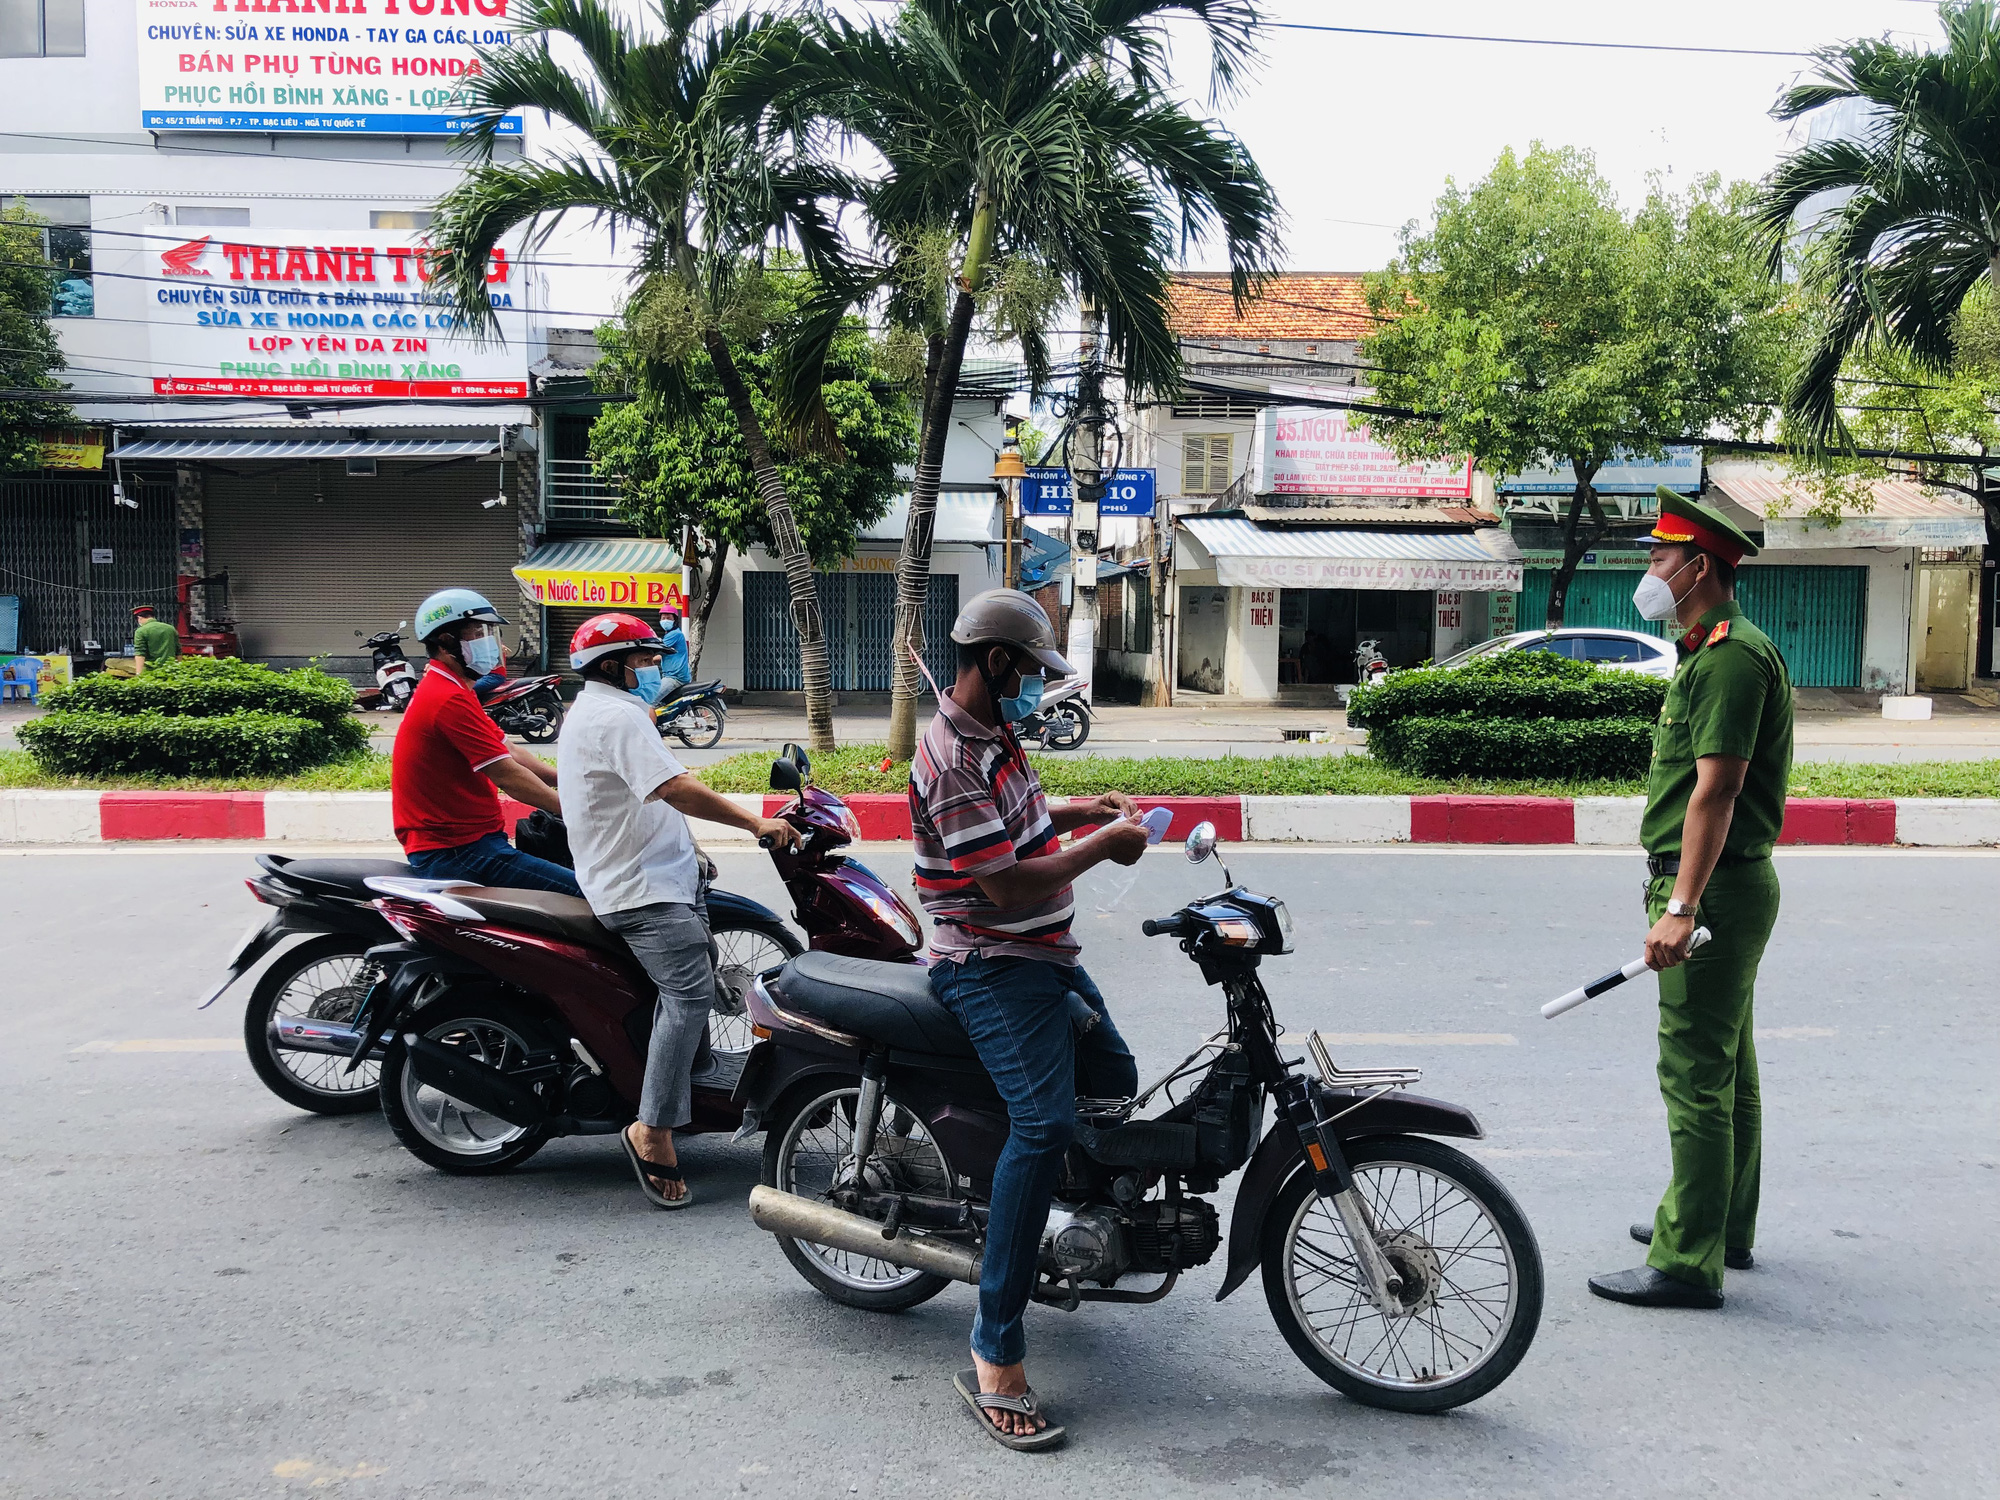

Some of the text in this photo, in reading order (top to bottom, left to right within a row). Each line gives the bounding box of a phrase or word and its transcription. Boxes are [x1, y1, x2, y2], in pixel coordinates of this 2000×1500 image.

[149, 0, 198, 8] HONDA
[147, 22, 221, 40] CHUYÊN:
[225, 19, 259, 41] SỬA
[264, 26, 286, 41] XE
[292, 26, 350, 42] HONDA
[366, 28, 399, 43] TAY
[405, 28, 427, 44] GA
[433, 26, 467, 45] CÁC
[178, 50, 483, 78] BÁN PHỤ TÙNG HONDA
[164, 86, 221, 107] PHỤC
[229, 81, 266, 105] HỒI
[273, 83, 324, 106] BÌNH
[332, 85, 389, 107] XĂNG
[409, 87, 450, 111] LỢP
[185, 116, 206, 125] TRẦN
[208, 116, 223, 126] PHÚ
[230, 118, 243, 126] P.7
[249, 118, 262, 127] TP.
[263, 117, 280, 128] BẠC
[305, 116, 321, 127] NGÃ
[321, 118, 334, 127] TƯ
[333, 117, 355, 128] QUỐC
[355, 117, 367, 128] TẾ
[162, 268, 212, 277] HONDA
[222, 244, 376, 283] THANH
[157, 286, 223, 304] CHUYÊN
[317, 291, 329, 306] &
[334, 288, 367, 306] BÁN
[196, 306, 242, 327] SỬA
[250, 312, 279, 326] XE
[288, 312, 364, 328] HONDA
[372, 310, 417, 329] CÁC
[248, 334, 427, 354] LỢP YÊN DA ZIN
[290, 357, 329, 378] HỒI
[338, 360, 391, 378] BÌNH
[400, 360, 461, 378] XĂNG
[217, 383, 233, 392] PHÚ
[272, 385, 289, 394] BẠC
[313, 383, 328, 393] NGÃ
[341, 384, 362, 394] QUỐC
[363, 384, 374, 393] TẾ
[1347, 449, 1368, 462] BỆNH
[1030, 472, 1058, 480] KHÓM
[1109, 486, 1137, 500] 10
[1102, 503, 1128, 512] PHÚ
[1246, 560, 1520, 582] BÁC SĨ NGUYỄN VĂN THIỆN
[548, 579, 578, 601] Nước
[582, 579, 605, 602] Lèo
[610, 576, 639, 605] DÌ
[646, 583, 683, 606] BA
[1251, 590, 1266, 604] BÁC
[1438, 592, 1453, 605] BÁC
[1250, 606, 1274, 629] THIỆN
[1438, 607, 1461, 631] THIỆN
[455, 928, 521, 950] VISION
